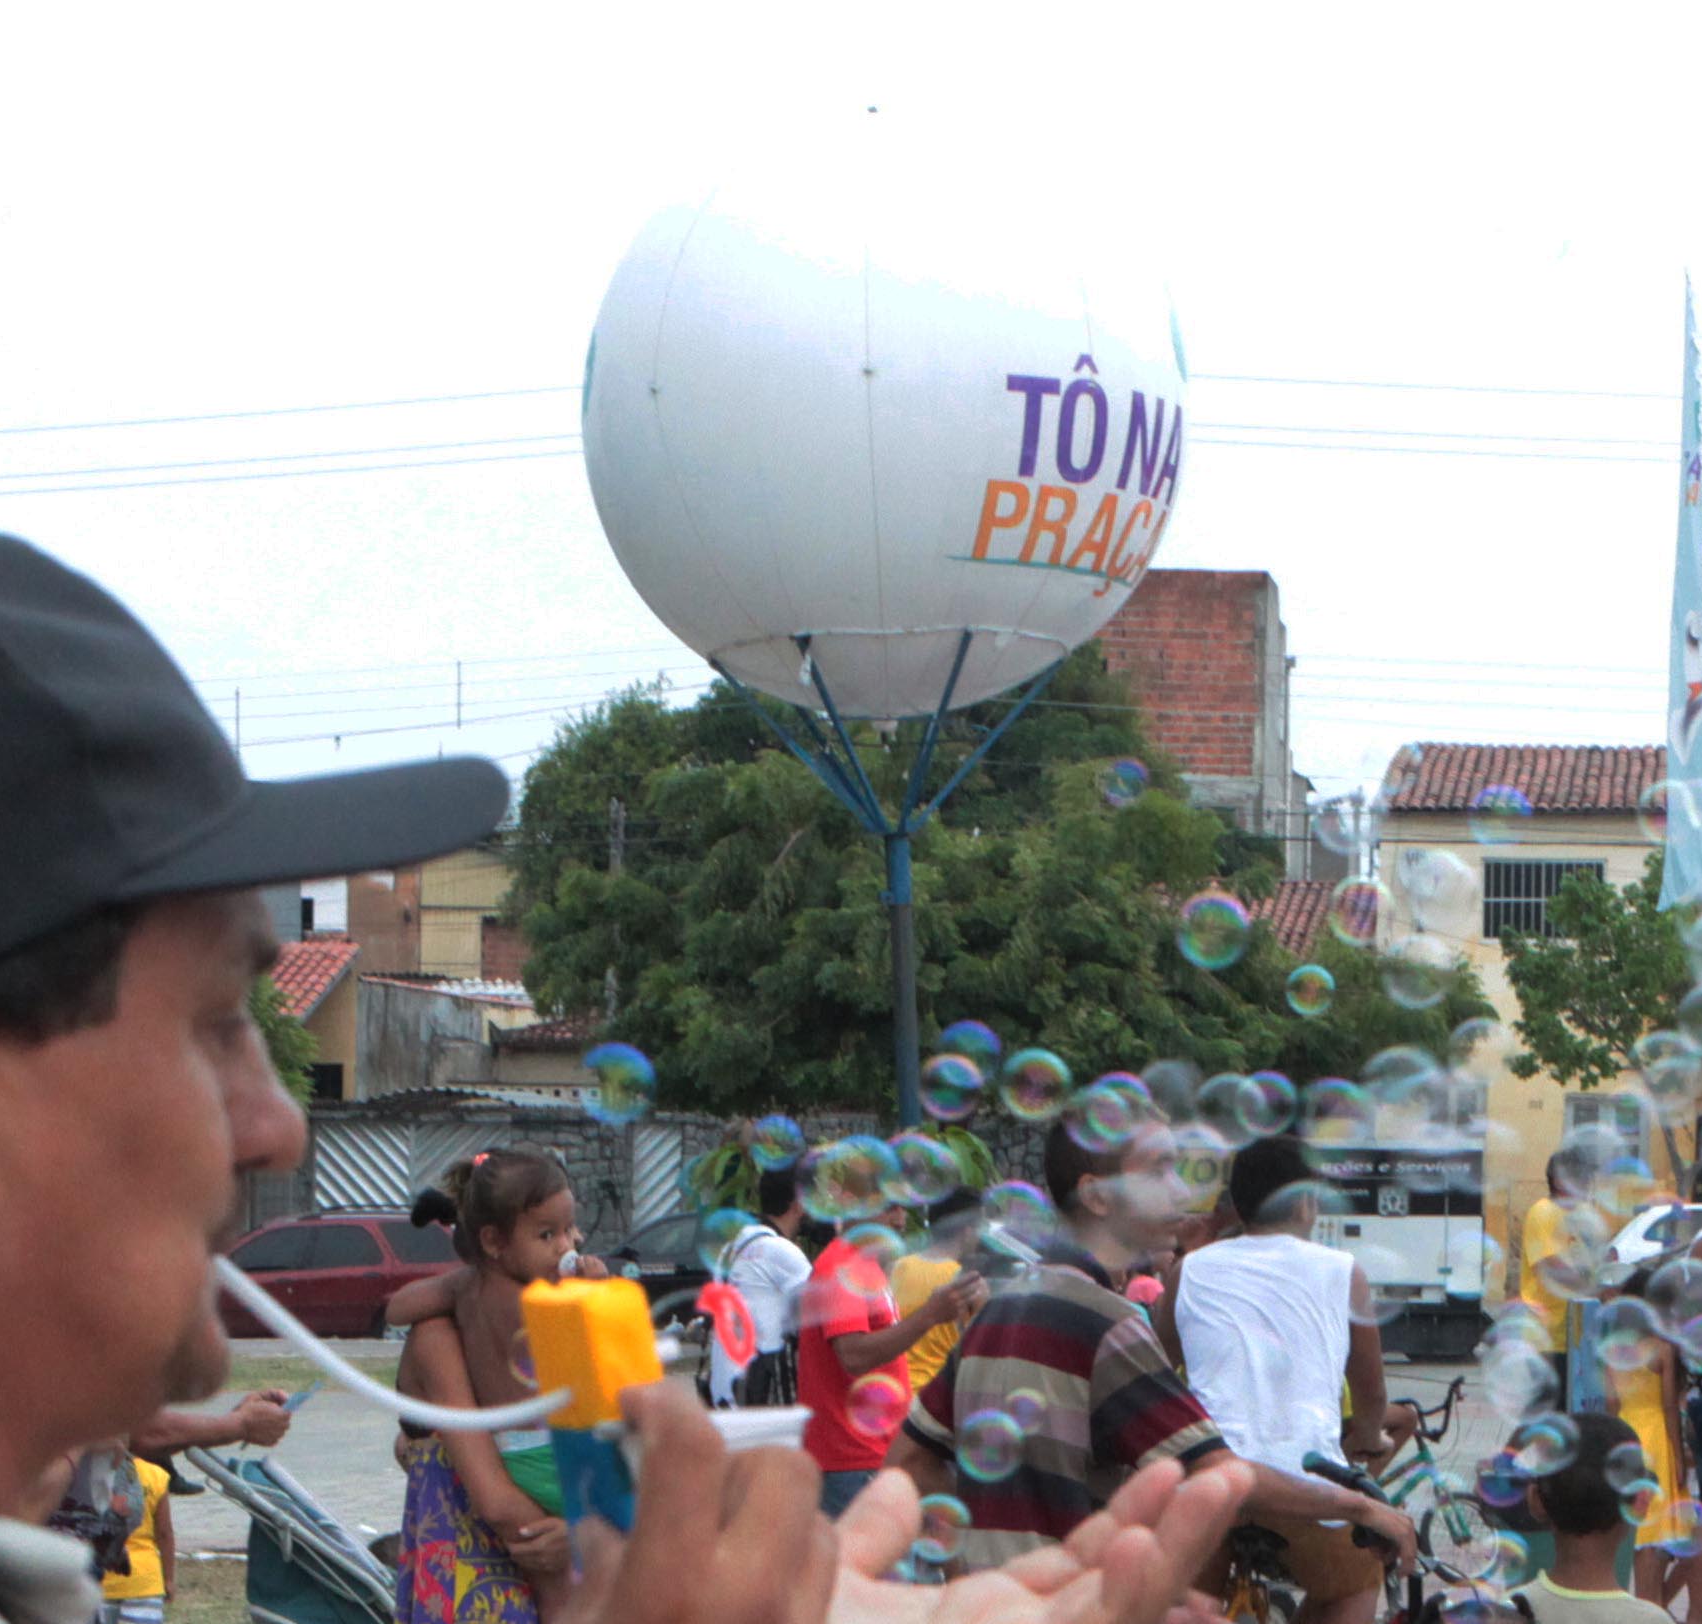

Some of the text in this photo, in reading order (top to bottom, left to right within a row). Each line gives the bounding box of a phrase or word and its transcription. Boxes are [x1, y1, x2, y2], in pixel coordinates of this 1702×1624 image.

[1006, 354, 1182, 506] TÔ NA
[971, 479, 1167, 598] PRAÇA
